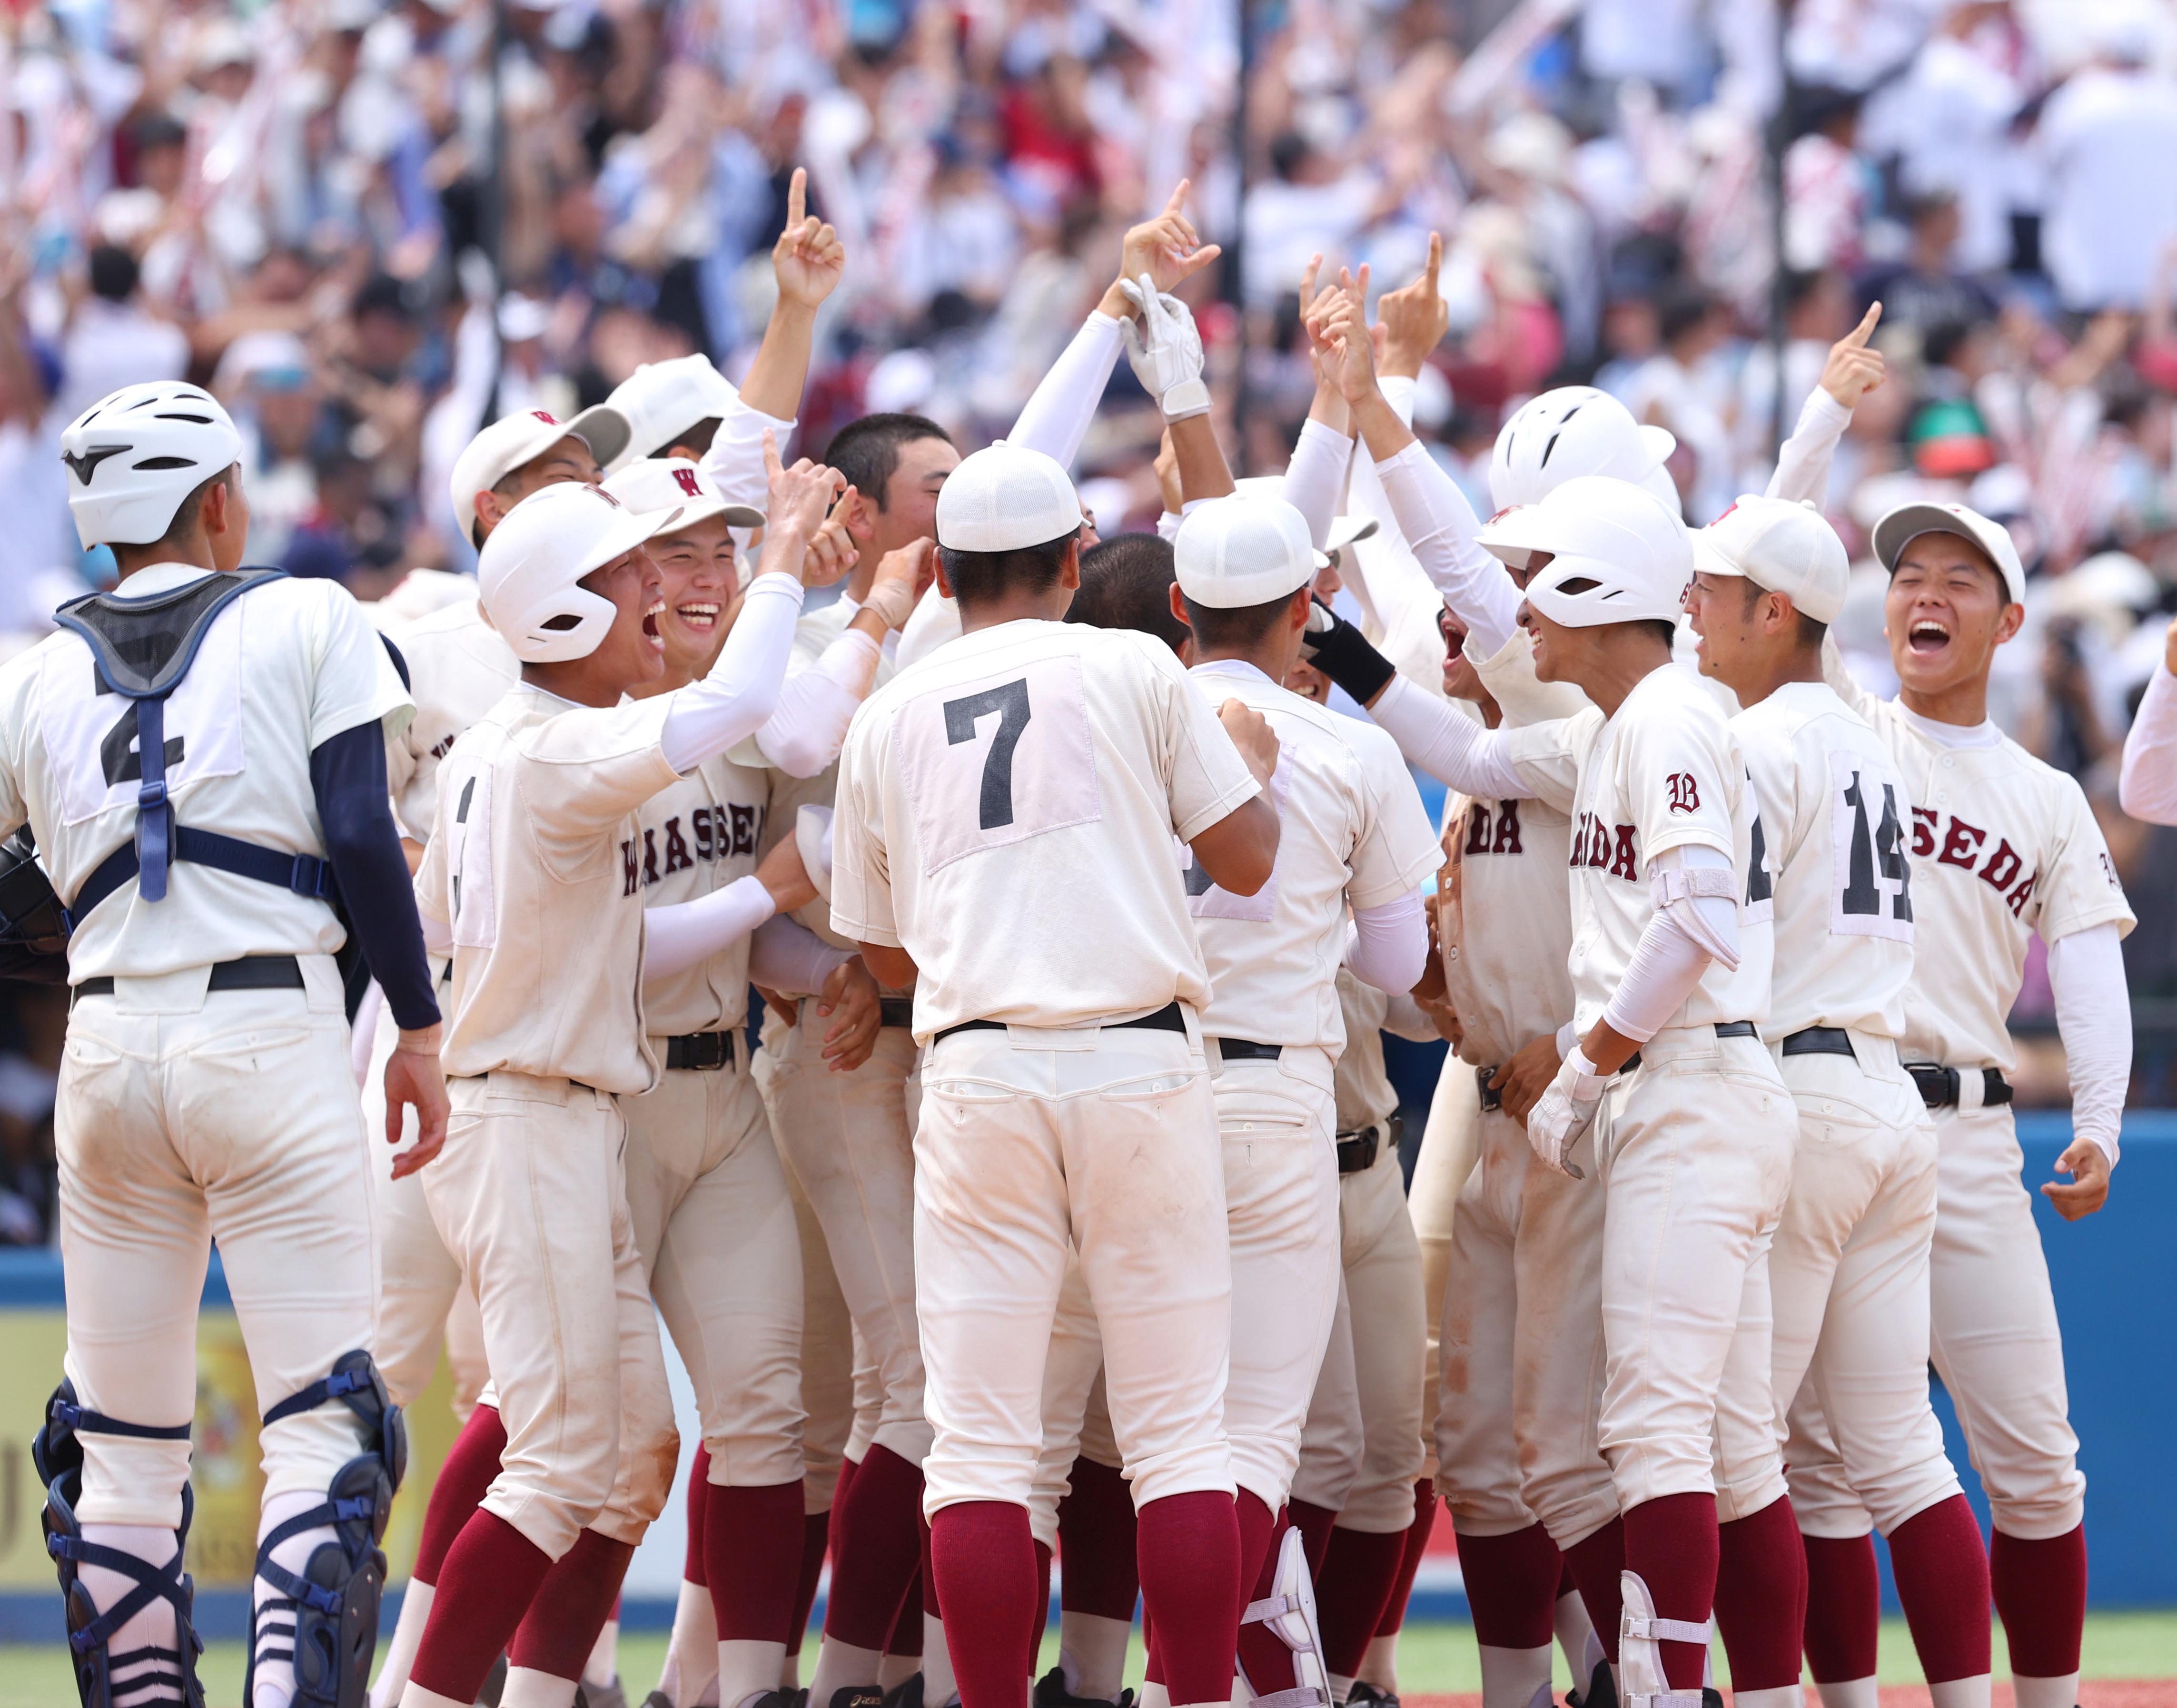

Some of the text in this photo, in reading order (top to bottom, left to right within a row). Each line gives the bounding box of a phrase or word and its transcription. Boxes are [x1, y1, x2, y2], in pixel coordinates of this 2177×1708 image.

[671, 468, 705, 496] W
[943, 677, 1031, 830] 7
[1666, 771, 1700, 815] B
[1842, 771, 1914, 924] 14
